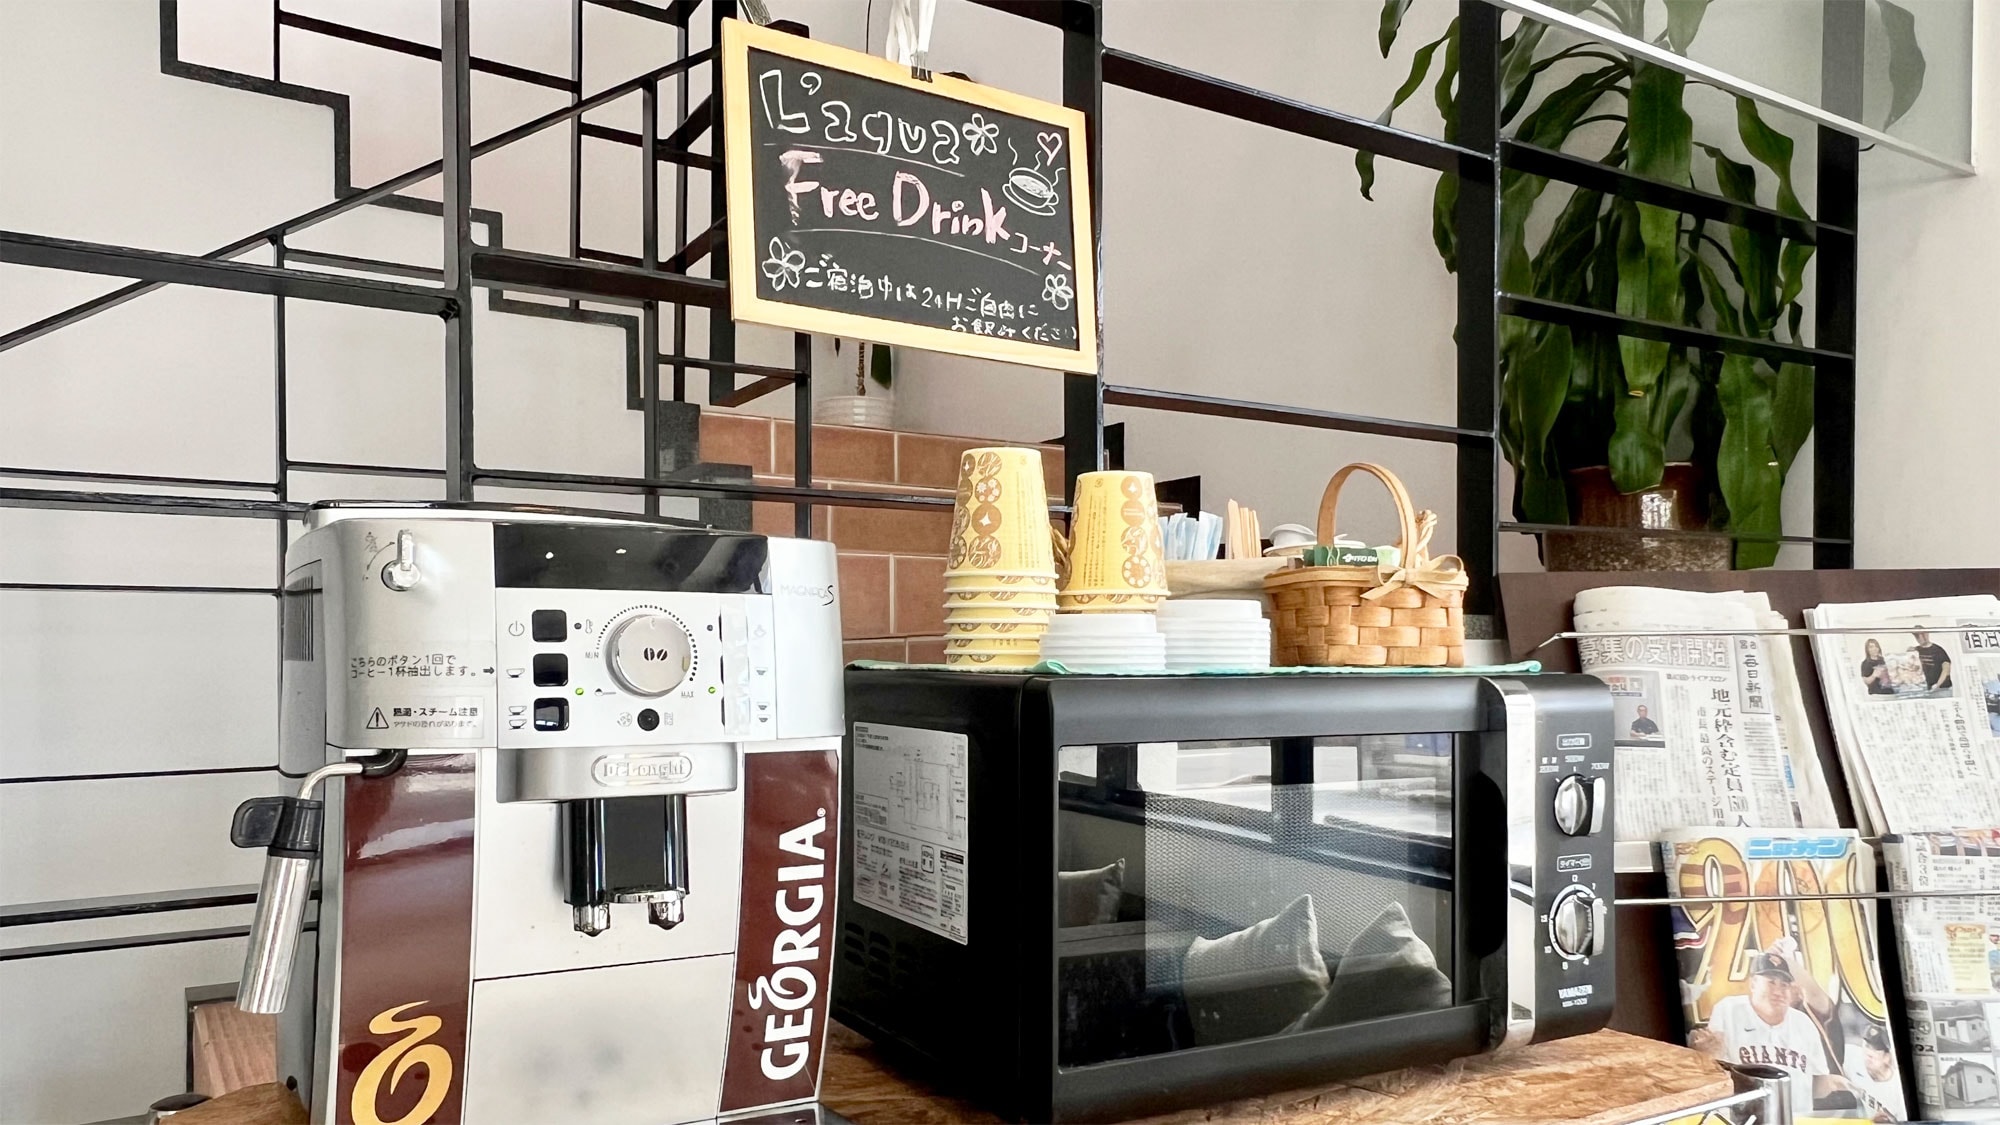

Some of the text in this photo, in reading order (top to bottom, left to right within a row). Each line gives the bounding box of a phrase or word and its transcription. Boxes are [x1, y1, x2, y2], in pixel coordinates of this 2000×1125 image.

[779, 150, 1011, 243] Free Drink
[1010, 233, 1072, 270] コーナー
[351, 653, 457, 668] こちらのボタン1回で
[749, 818, 826, 1080] GEORGIA
